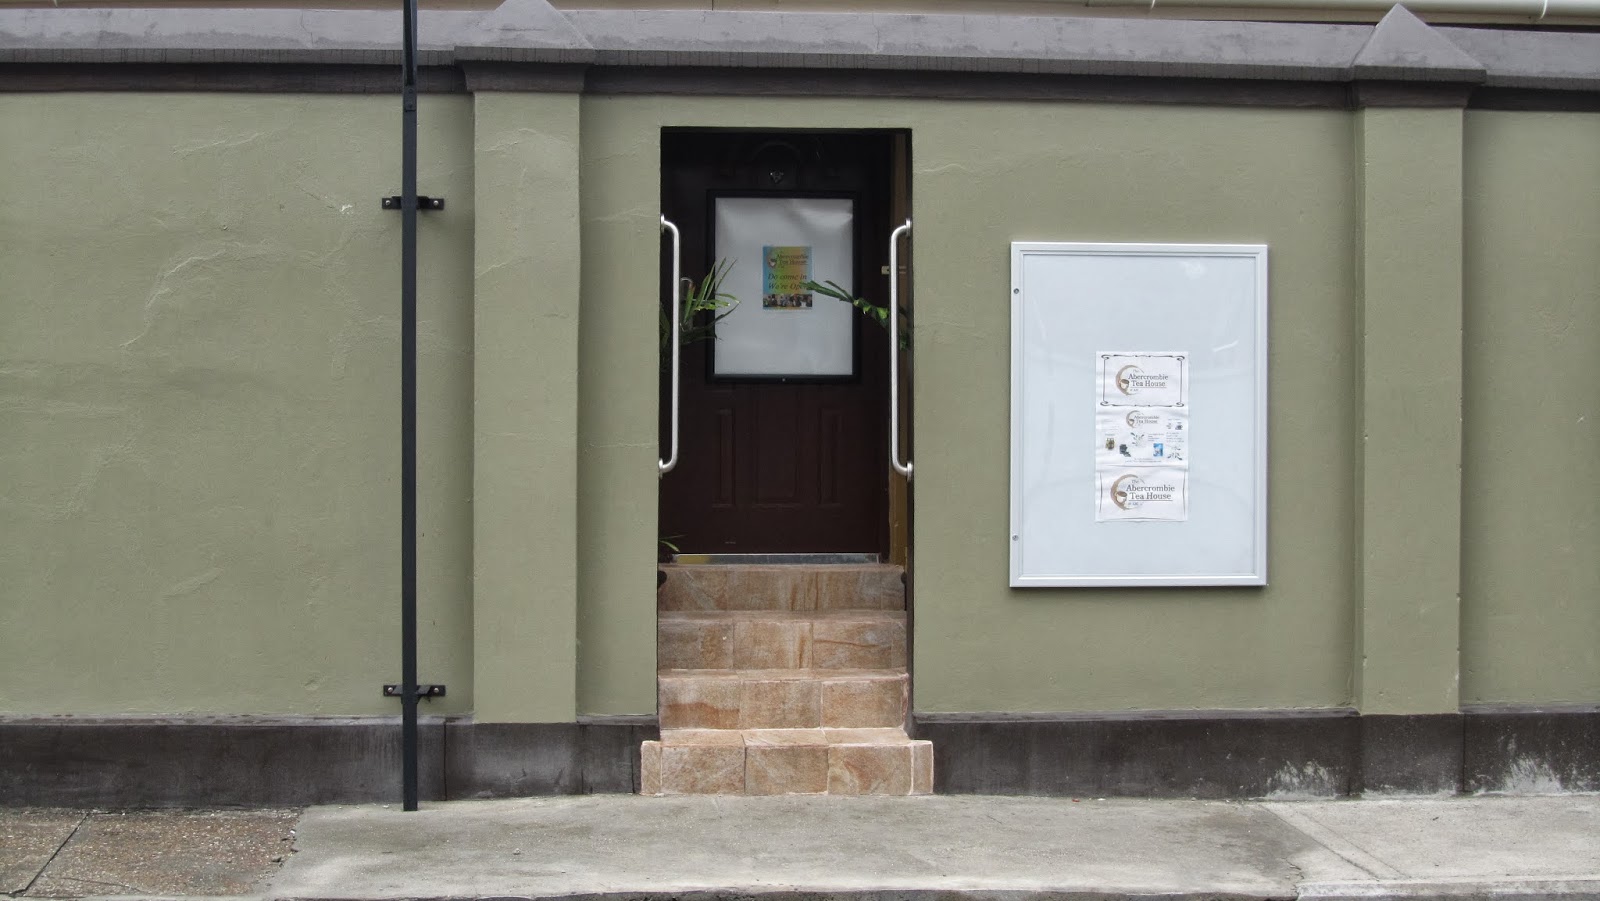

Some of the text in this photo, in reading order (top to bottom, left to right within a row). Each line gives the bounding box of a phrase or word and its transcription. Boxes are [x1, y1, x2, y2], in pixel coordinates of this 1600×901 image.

[1126, 484, 1175, 492] Abercrombie
[1129, 492, 1172, 500] Tea House
